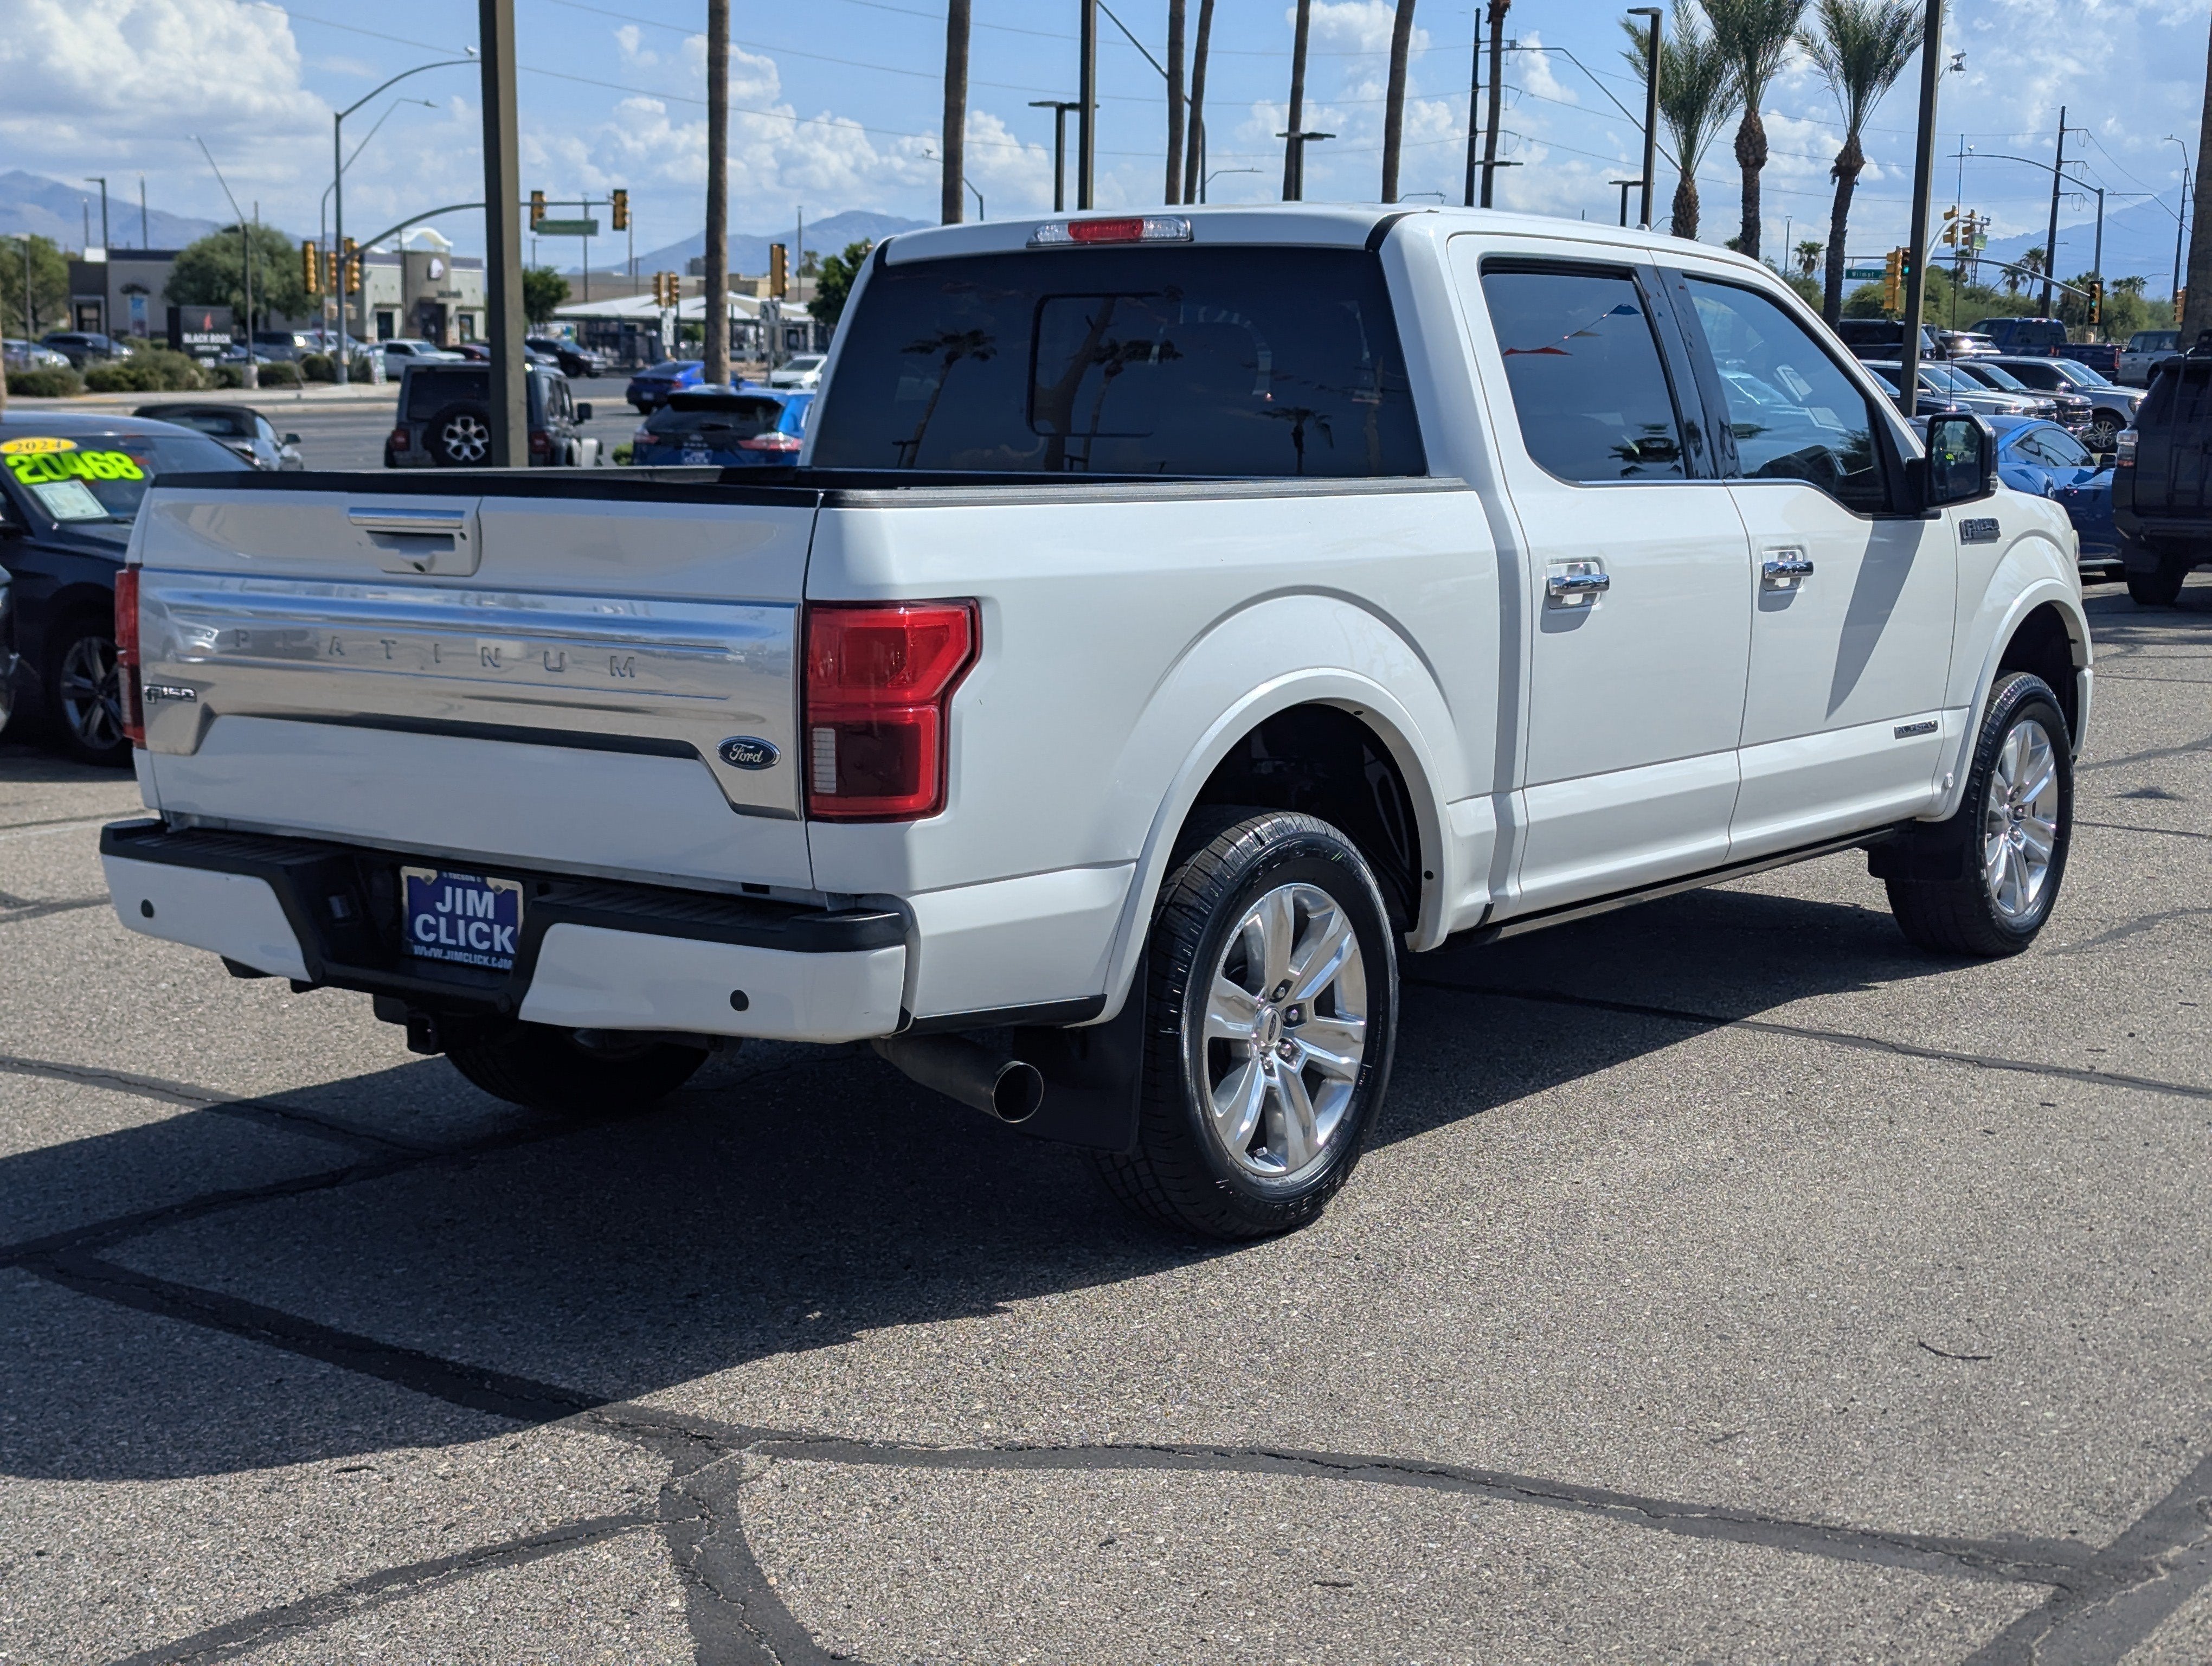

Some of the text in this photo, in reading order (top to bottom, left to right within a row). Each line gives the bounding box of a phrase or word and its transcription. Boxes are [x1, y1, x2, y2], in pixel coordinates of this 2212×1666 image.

[14, 439, 62, 452] 2024
[5, 450, 144, 485] 20468
[234, 628, 636, 678] PLATINUM
[729, 743, 763, 762] Ford
[435, 886, 494, 919] JIM
[415, 914, 515, 954] CLICK
[414, 945, 512, 970] WWW.JIMCLICK.COM
